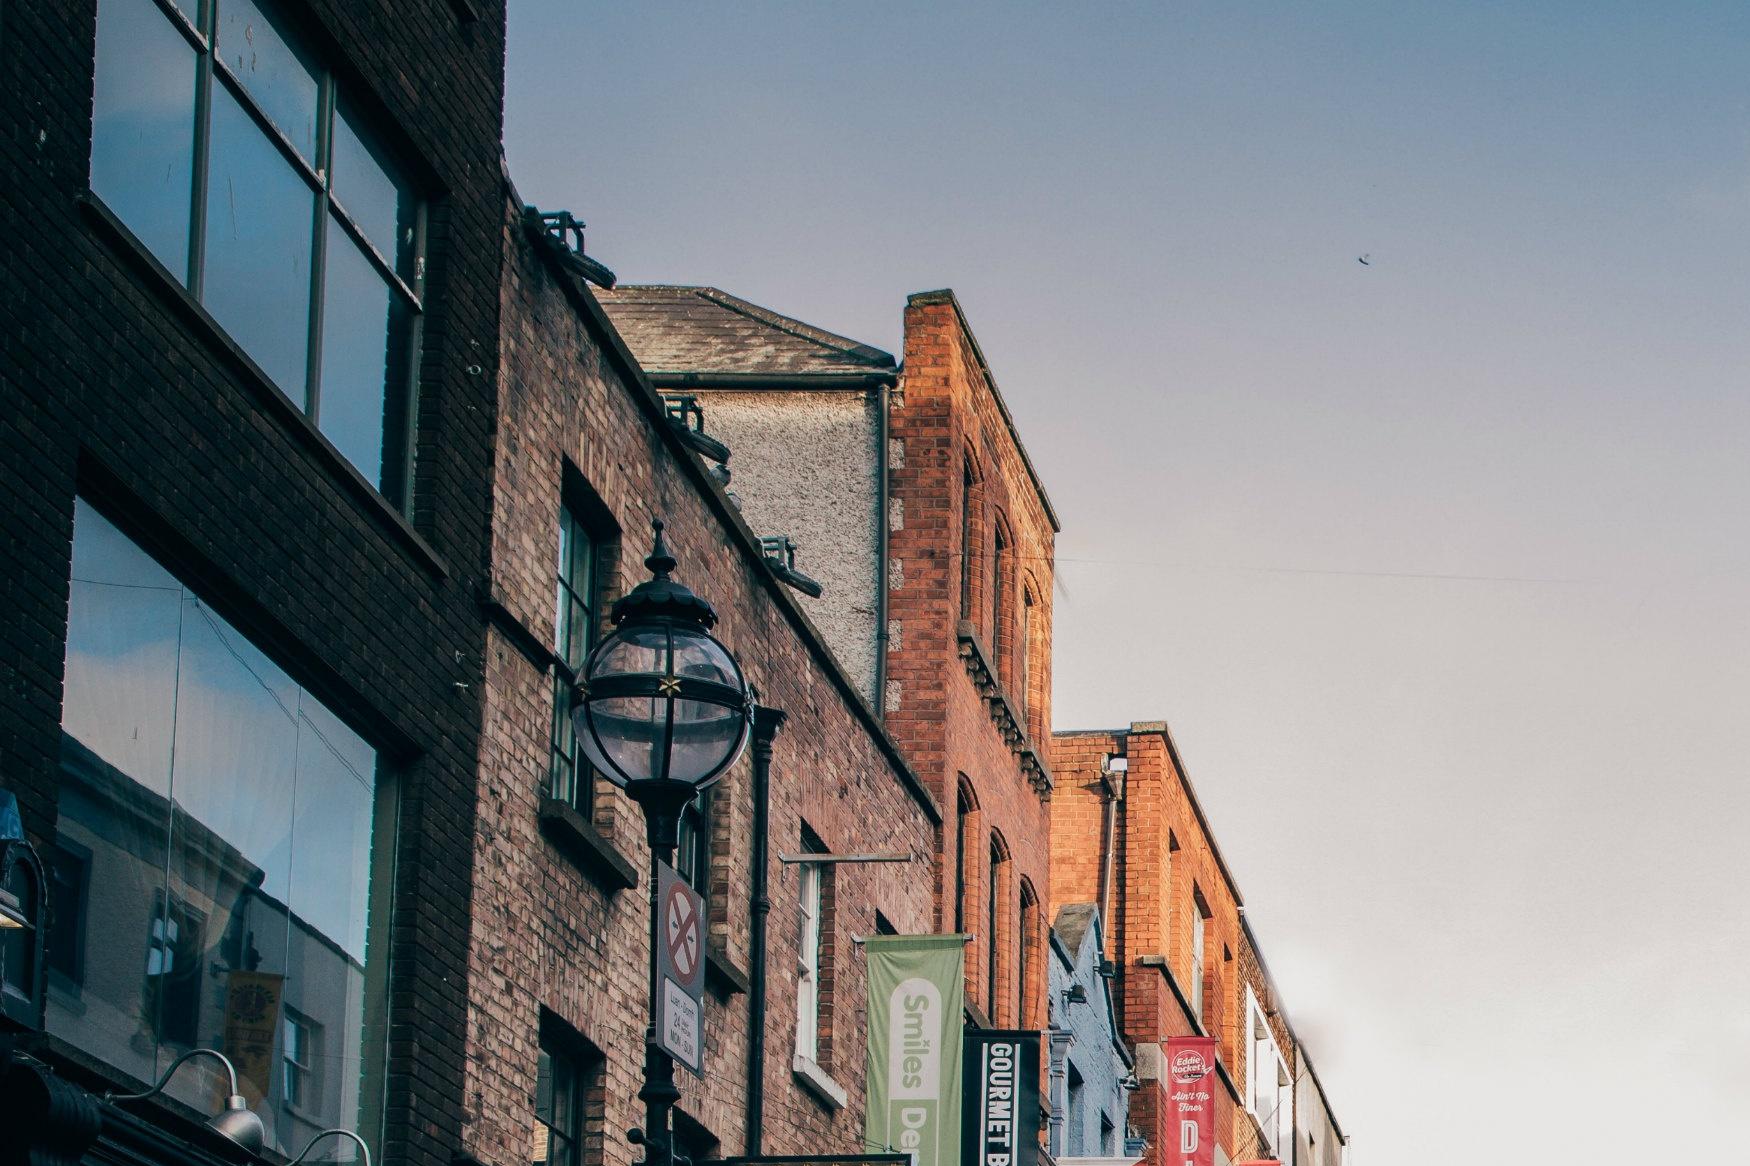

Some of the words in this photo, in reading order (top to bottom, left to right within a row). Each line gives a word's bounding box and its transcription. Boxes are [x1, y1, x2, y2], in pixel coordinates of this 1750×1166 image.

[904, 994, 930, 1089] Smiles
[1176, 1056, 1201, 1066] Eddie
[986, 1042, 1014, 1148] GOURMET
